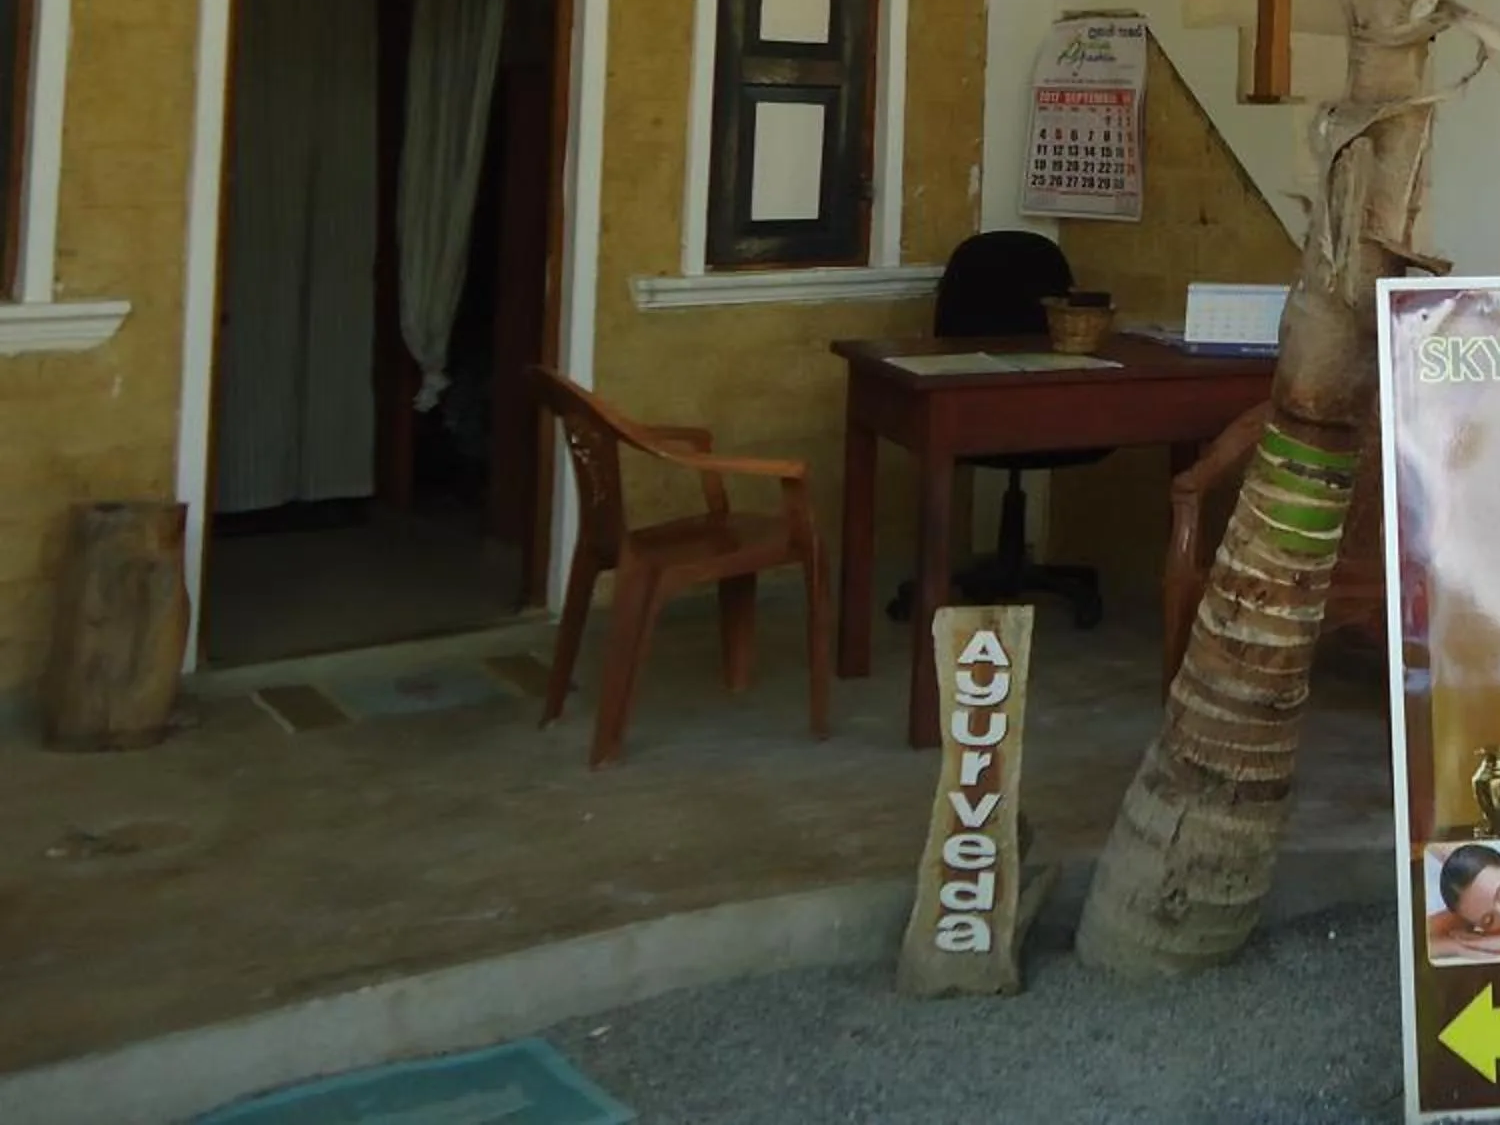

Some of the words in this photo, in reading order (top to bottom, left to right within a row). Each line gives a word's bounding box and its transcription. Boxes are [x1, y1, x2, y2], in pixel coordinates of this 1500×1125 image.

[1040, 128, 1046, 139] 4
[1070, 129, 1078, 141] 6
[1088, 130, 1094, 141] 7
[1037, 144, 1047, 155] 11
[1053, 144, 1064, 155] 12
[1068, 145, 1079, 156] 13
[1084, 146, 1095, 157] 14
[1101, 147, 1112, 157] 15
[1066, 160, 1079, 171] 20
[1082, 161, 1095, 172] 21
[1098, 162, 1112, 173] 22
[1032, 174, 1045, 186] 25
[1049, 175, 1063, 186] 26
[1066, 176, 1079, 187] 27
[1082, 177, 1095, 188] 28
[1098, 178, 1110, 189] 29
[935, 629, 1010, 953] Ayurveda
